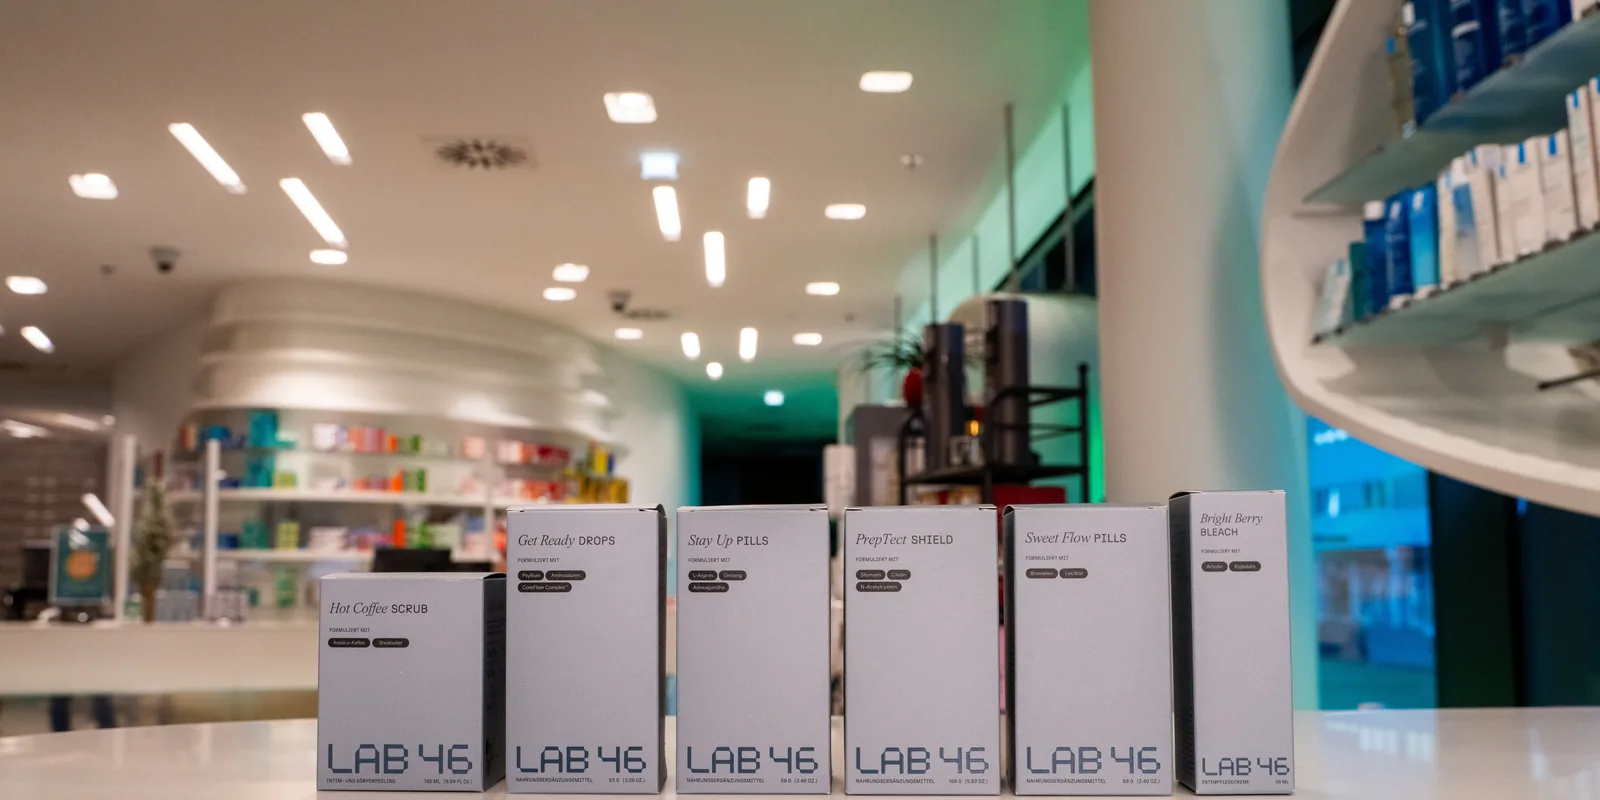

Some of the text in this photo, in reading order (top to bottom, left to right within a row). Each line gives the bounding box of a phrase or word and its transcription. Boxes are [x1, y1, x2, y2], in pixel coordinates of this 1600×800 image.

[1200, 513, 1263, 526] Bright Berry
[1025, 532, 1126, 544] Sweet Flow PILLS
[1200, 528, 1238, 536] BLEACH
[518, 534, 616, 548] Get Ready DROPS
[688, 534, 768, 548] Stay Up PILLS
[856, 534, 953, 548] PrepTect SHIELD
[329, 602, 428, 616] Hot Coffee SCRUB
[328, 744, 408, 774] LAB
[418, 744, 472, 774] 46
[516, 746, 588, 773] LAB
[598, 746, 646, 773] 46
[687, 746, 818, 774] LAB 46
[856, 747, 989, 774] LAB 46
[1027, 747, 1161, 774] LAB 46
[1202, 758, 1289, 776] LAB 46
